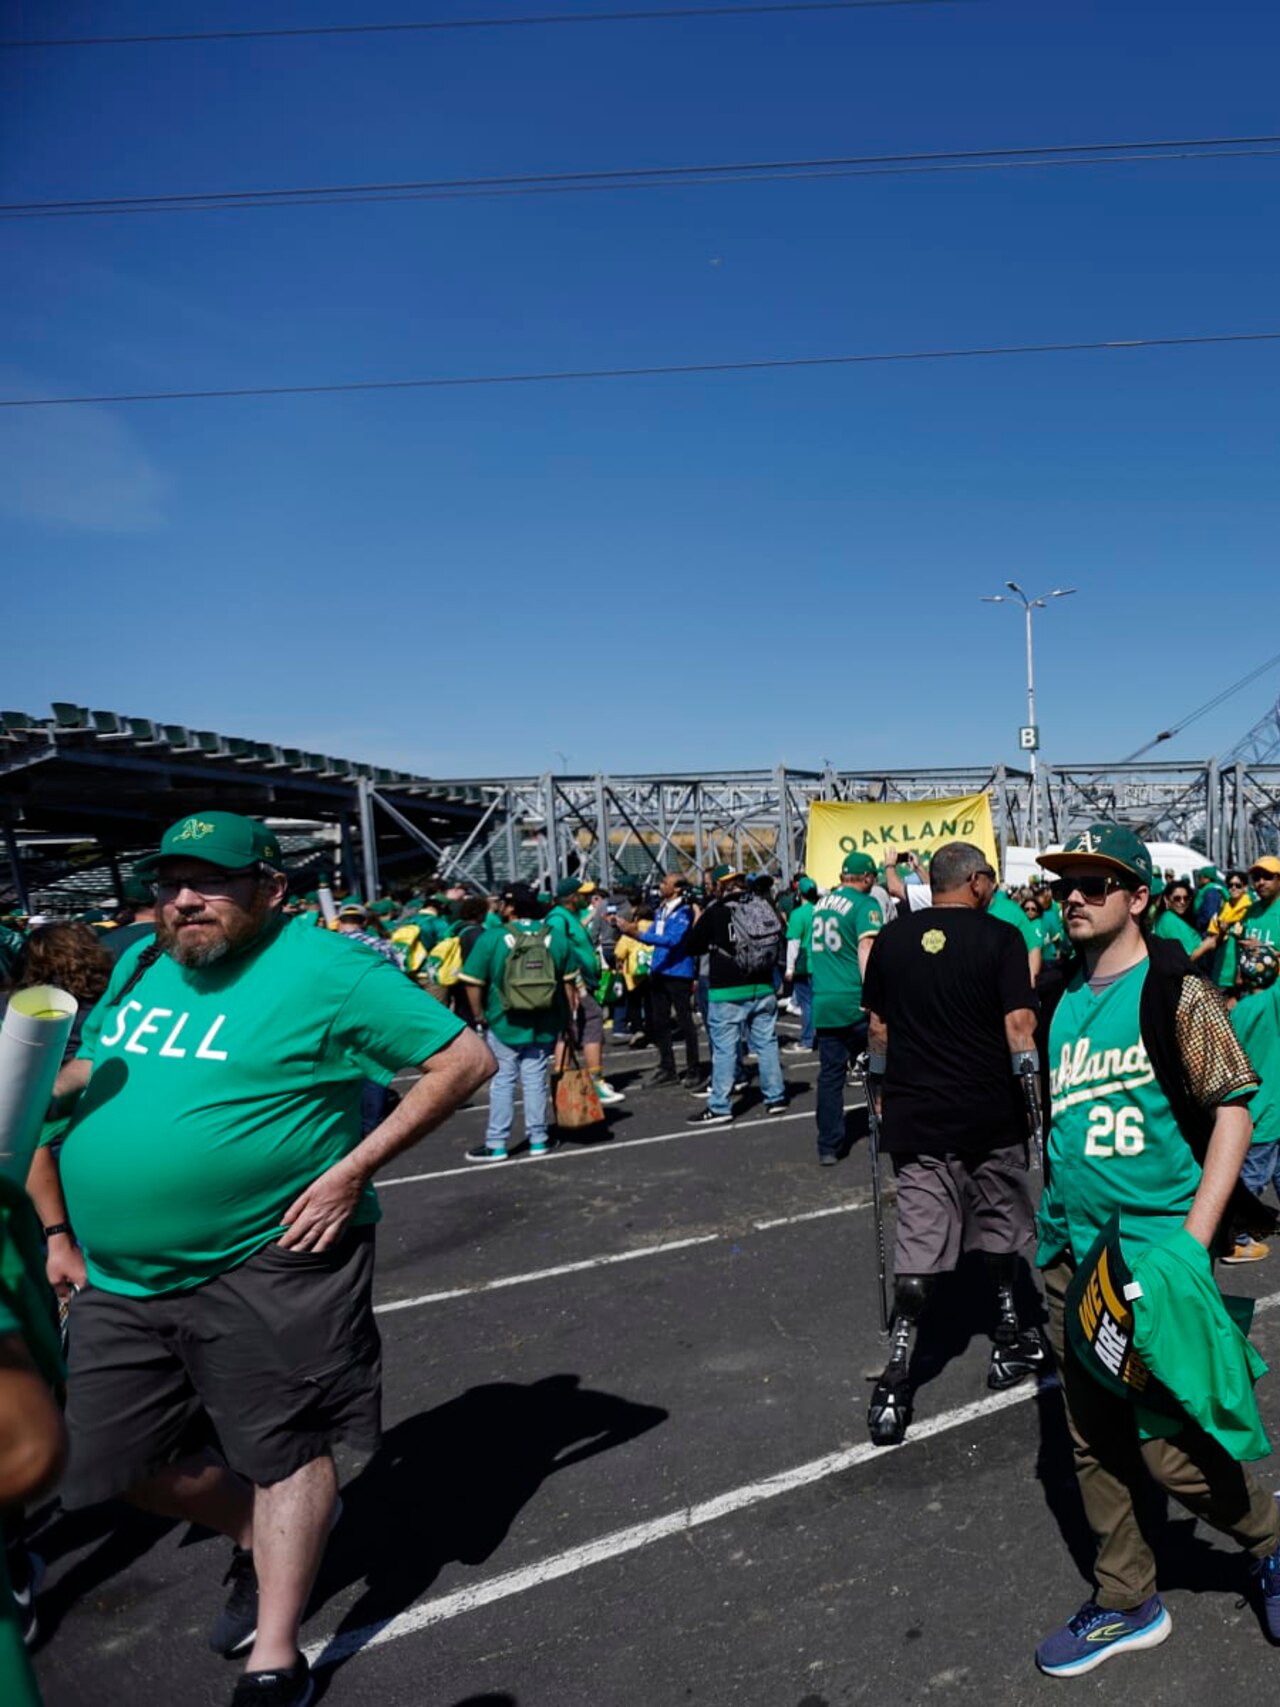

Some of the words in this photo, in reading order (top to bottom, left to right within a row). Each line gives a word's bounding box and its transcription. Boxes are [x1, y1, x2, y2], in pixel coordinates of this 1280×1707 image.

[1021, 728, 1036, 748] B
[839, 820, 975, 853] OAKLAND
[812, 916, 842, 952] 26
[100, 1000, 228, 1060] SELL
[1050, 1037, 1153, 1096] akland
[1084, 1105, 1144, 1156] 26
[1080, 1269, 1103, 1342] WE
[1094, 1311, 1128, 1376] ARE
